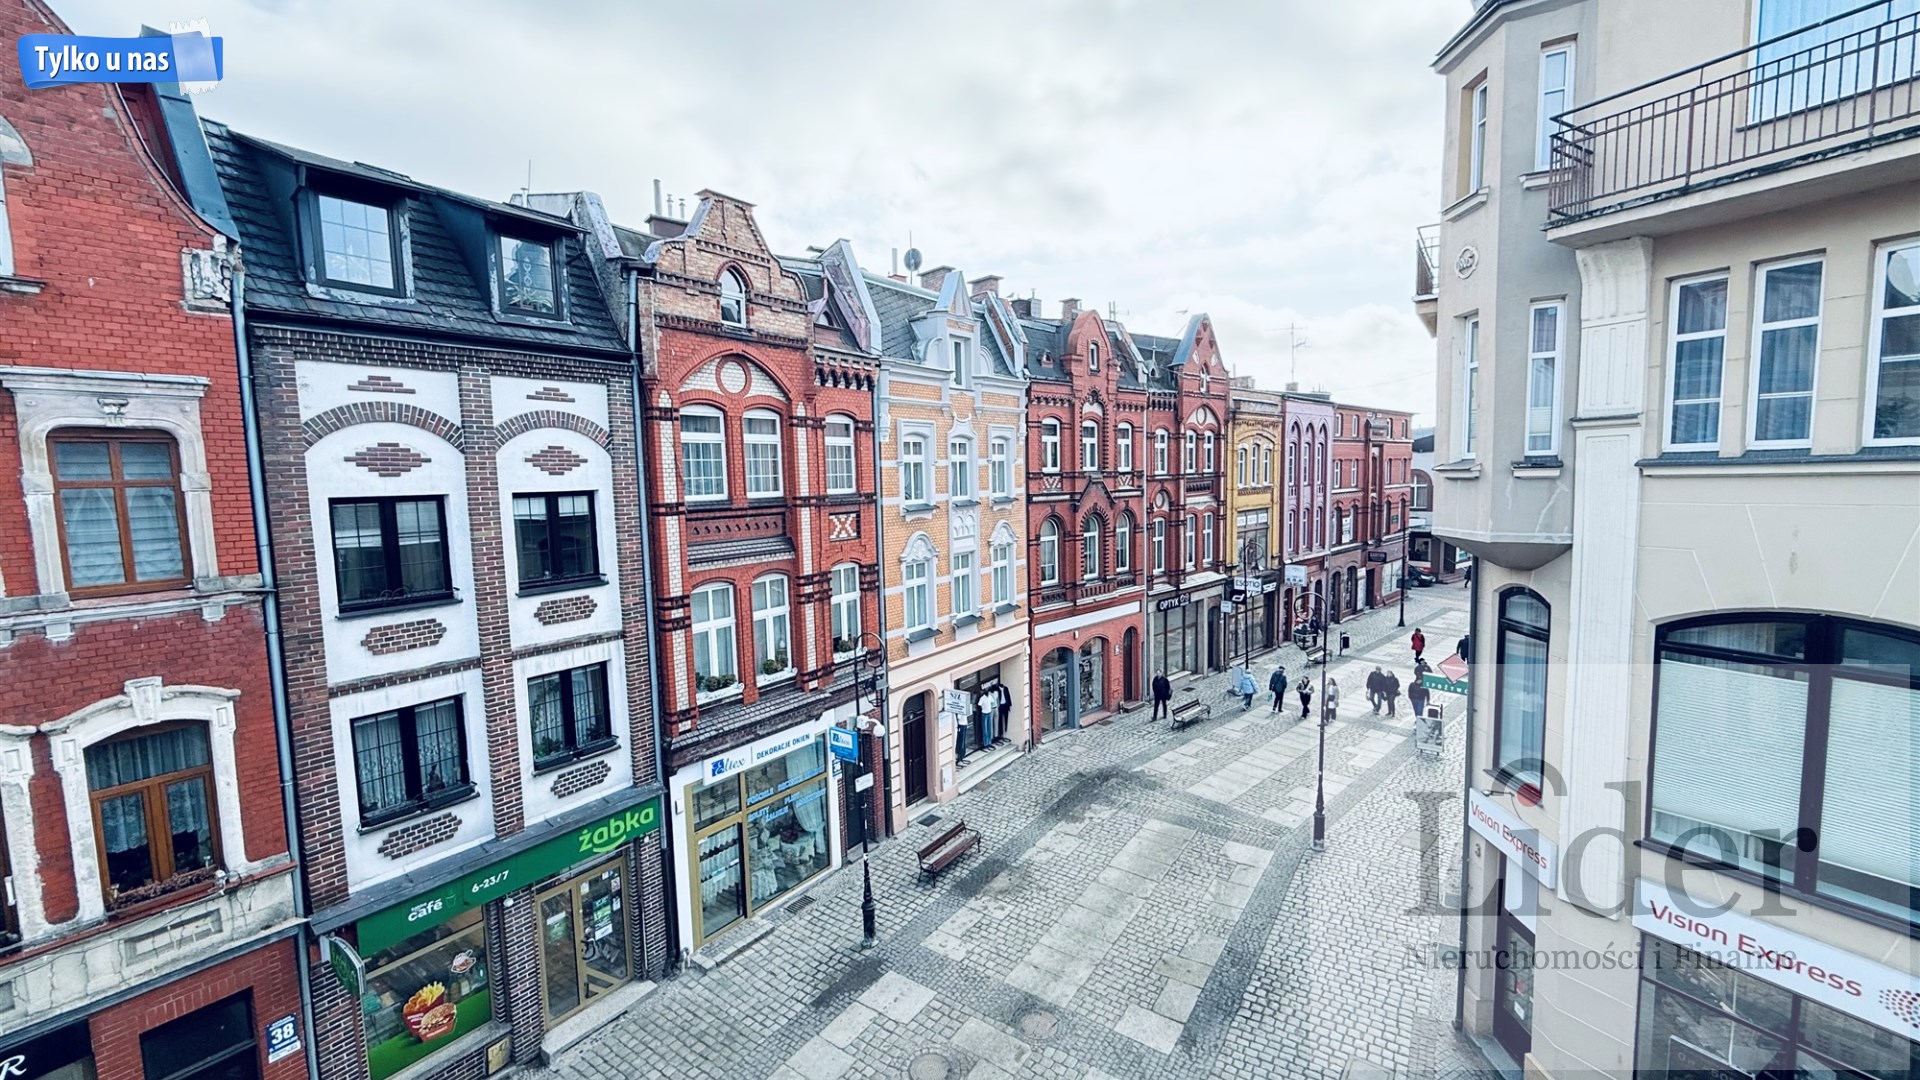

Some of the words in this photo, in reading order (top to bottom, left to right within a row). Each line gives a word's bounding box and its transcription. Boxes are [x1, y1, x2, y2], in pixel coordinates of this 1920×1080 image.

[1160, 597, 1179, 610] OPTYK
[756, 741, 791, 760] DEKORACJE
[792, 733, 810, 746] OKIEN
[579, 807, 655, 853] żabka
[1471, 800, 1500, 834] Vision
[1503, 823, 1548, 870] Express
[1474, 843, 1482, 858] 3
[471, 869, 510, 894] 6-23/7
[408, 897, 443, 922] café
[1649, 899, 1728, 947] Vision
[1738, 933, 1863, 998] Express
[271, 1022, 295, 1045] 38
